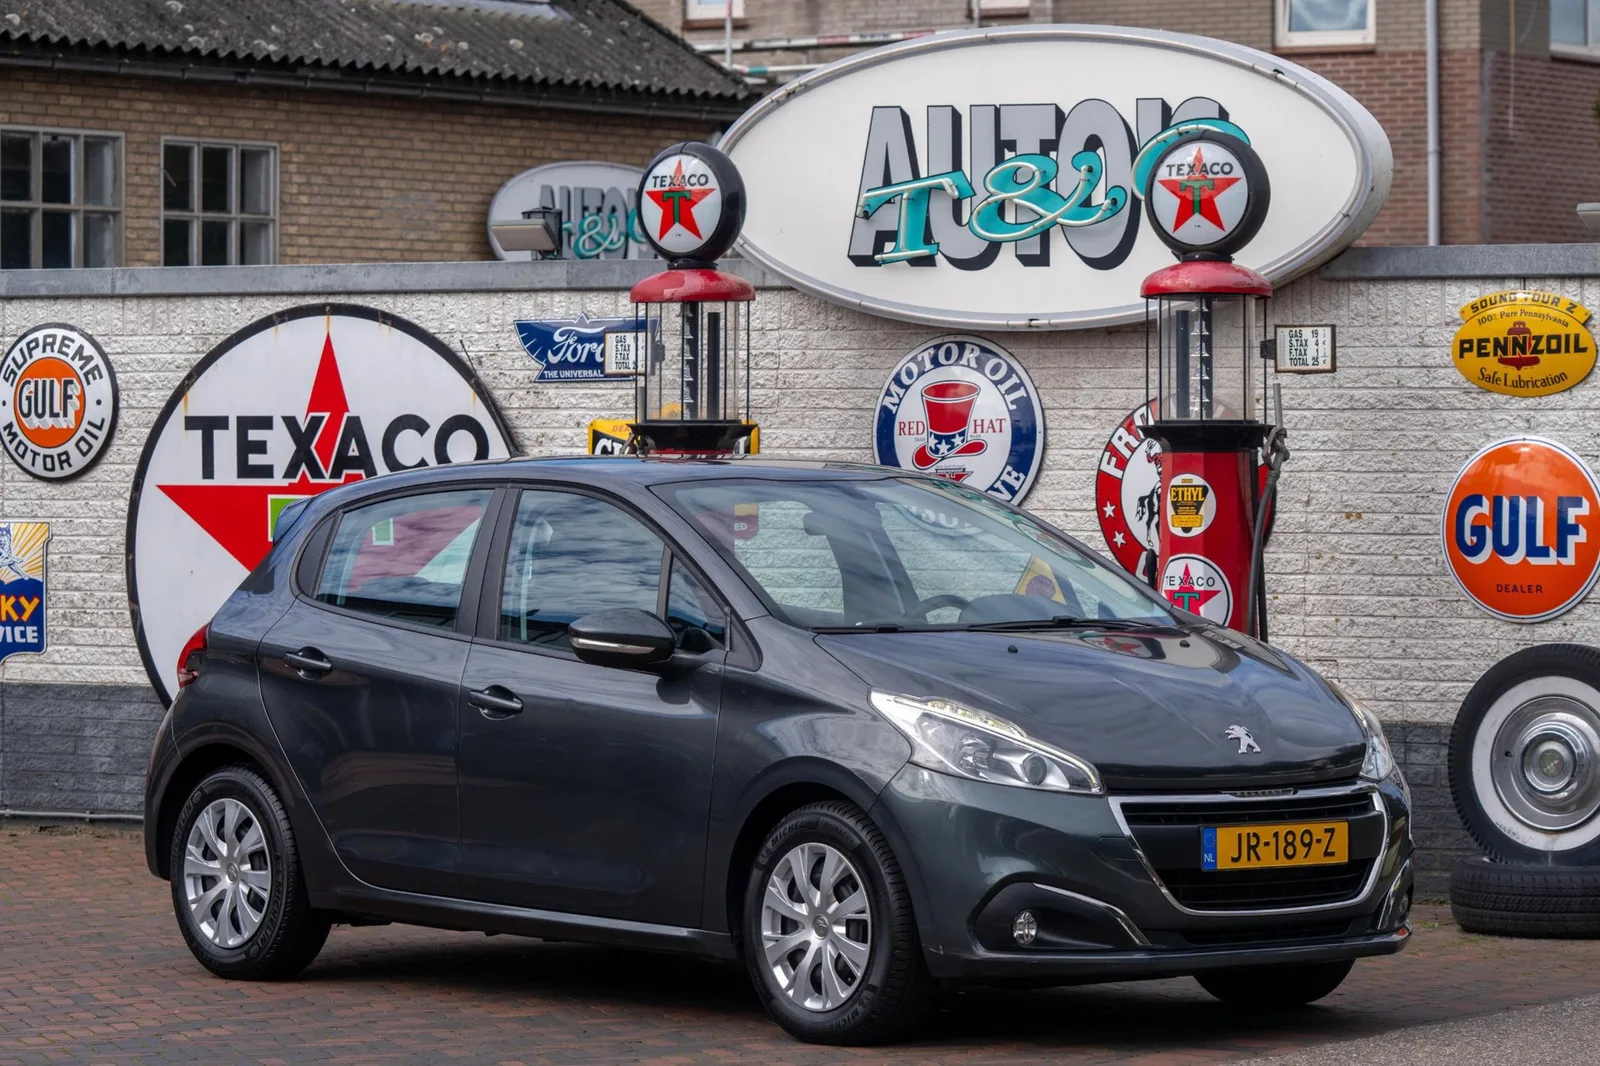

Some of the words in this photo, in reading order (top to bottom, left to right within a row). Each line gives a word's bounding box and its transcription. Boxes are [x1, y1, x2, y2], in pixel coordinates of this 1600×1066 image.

[1166, 162, 1234, 177] TEXACO
[652, 174, 709, 188] TEXACO
[847, 96, 1230, 271] AUTO'
[1179, 178, 1215, 215] T
[662, 190, 692, 224] T
[1470, 292, 1518, 313] SOUND
[1566, 302, 1578, 314] Z
[1500, 309, 1519, 319] Pure
[1519, 309, 1570, 328] Pennsylvania
[615, 335, 627, 344] GAS
[1288, 329, 1303, 338] GAS
[1311, 329, 1319, 338] 19
[615, 343, 631, 352] S.TAX
[1288, 339, 1309, 348] S.TAX
[1314, 339, 1319, 348] 4
[1288, 348, 1307, 357] F.TAX
[1459, 333, 1589, 359] PENNZOIL
[3, 333, 104, 388] SUPREME
[615, 352, 630, 361] F.TAX
[615, 361, 631, 370] TOTAL
[1288, 357, 1309, 367] TOTAL
[1311, 357, 1320, 366] 25
[543, 370, 559, 378] THE
[559, 369, 604, 378] UNIVERSAL
[882, 343, 981, 415] MOTOR
[984, 358, 1028, 411] OIL
[1477, 367, 1502, 386] Safe
[1503, 371, 1569, 389] Lubrication
[19, 379, 78, 425] GULF
[612, 424, 631, 433] DEA
[898, 420, 926, 436] RED
[972, 418, 1007, 435] HAT
[3, 421, 73, 473] MOTOR
[74, 417, 106, 458] OIL
[184, 413, 489, 480] TEXACO
[1171, 487, 1205, 501] ETHYL
[1456, 494, 1588, 563] GULF
[1496, 583, 1543, 594] DEALER
[1204, 853, 1215, 863] NL
[1231, 827, 1336, 863] JR-189-Z
